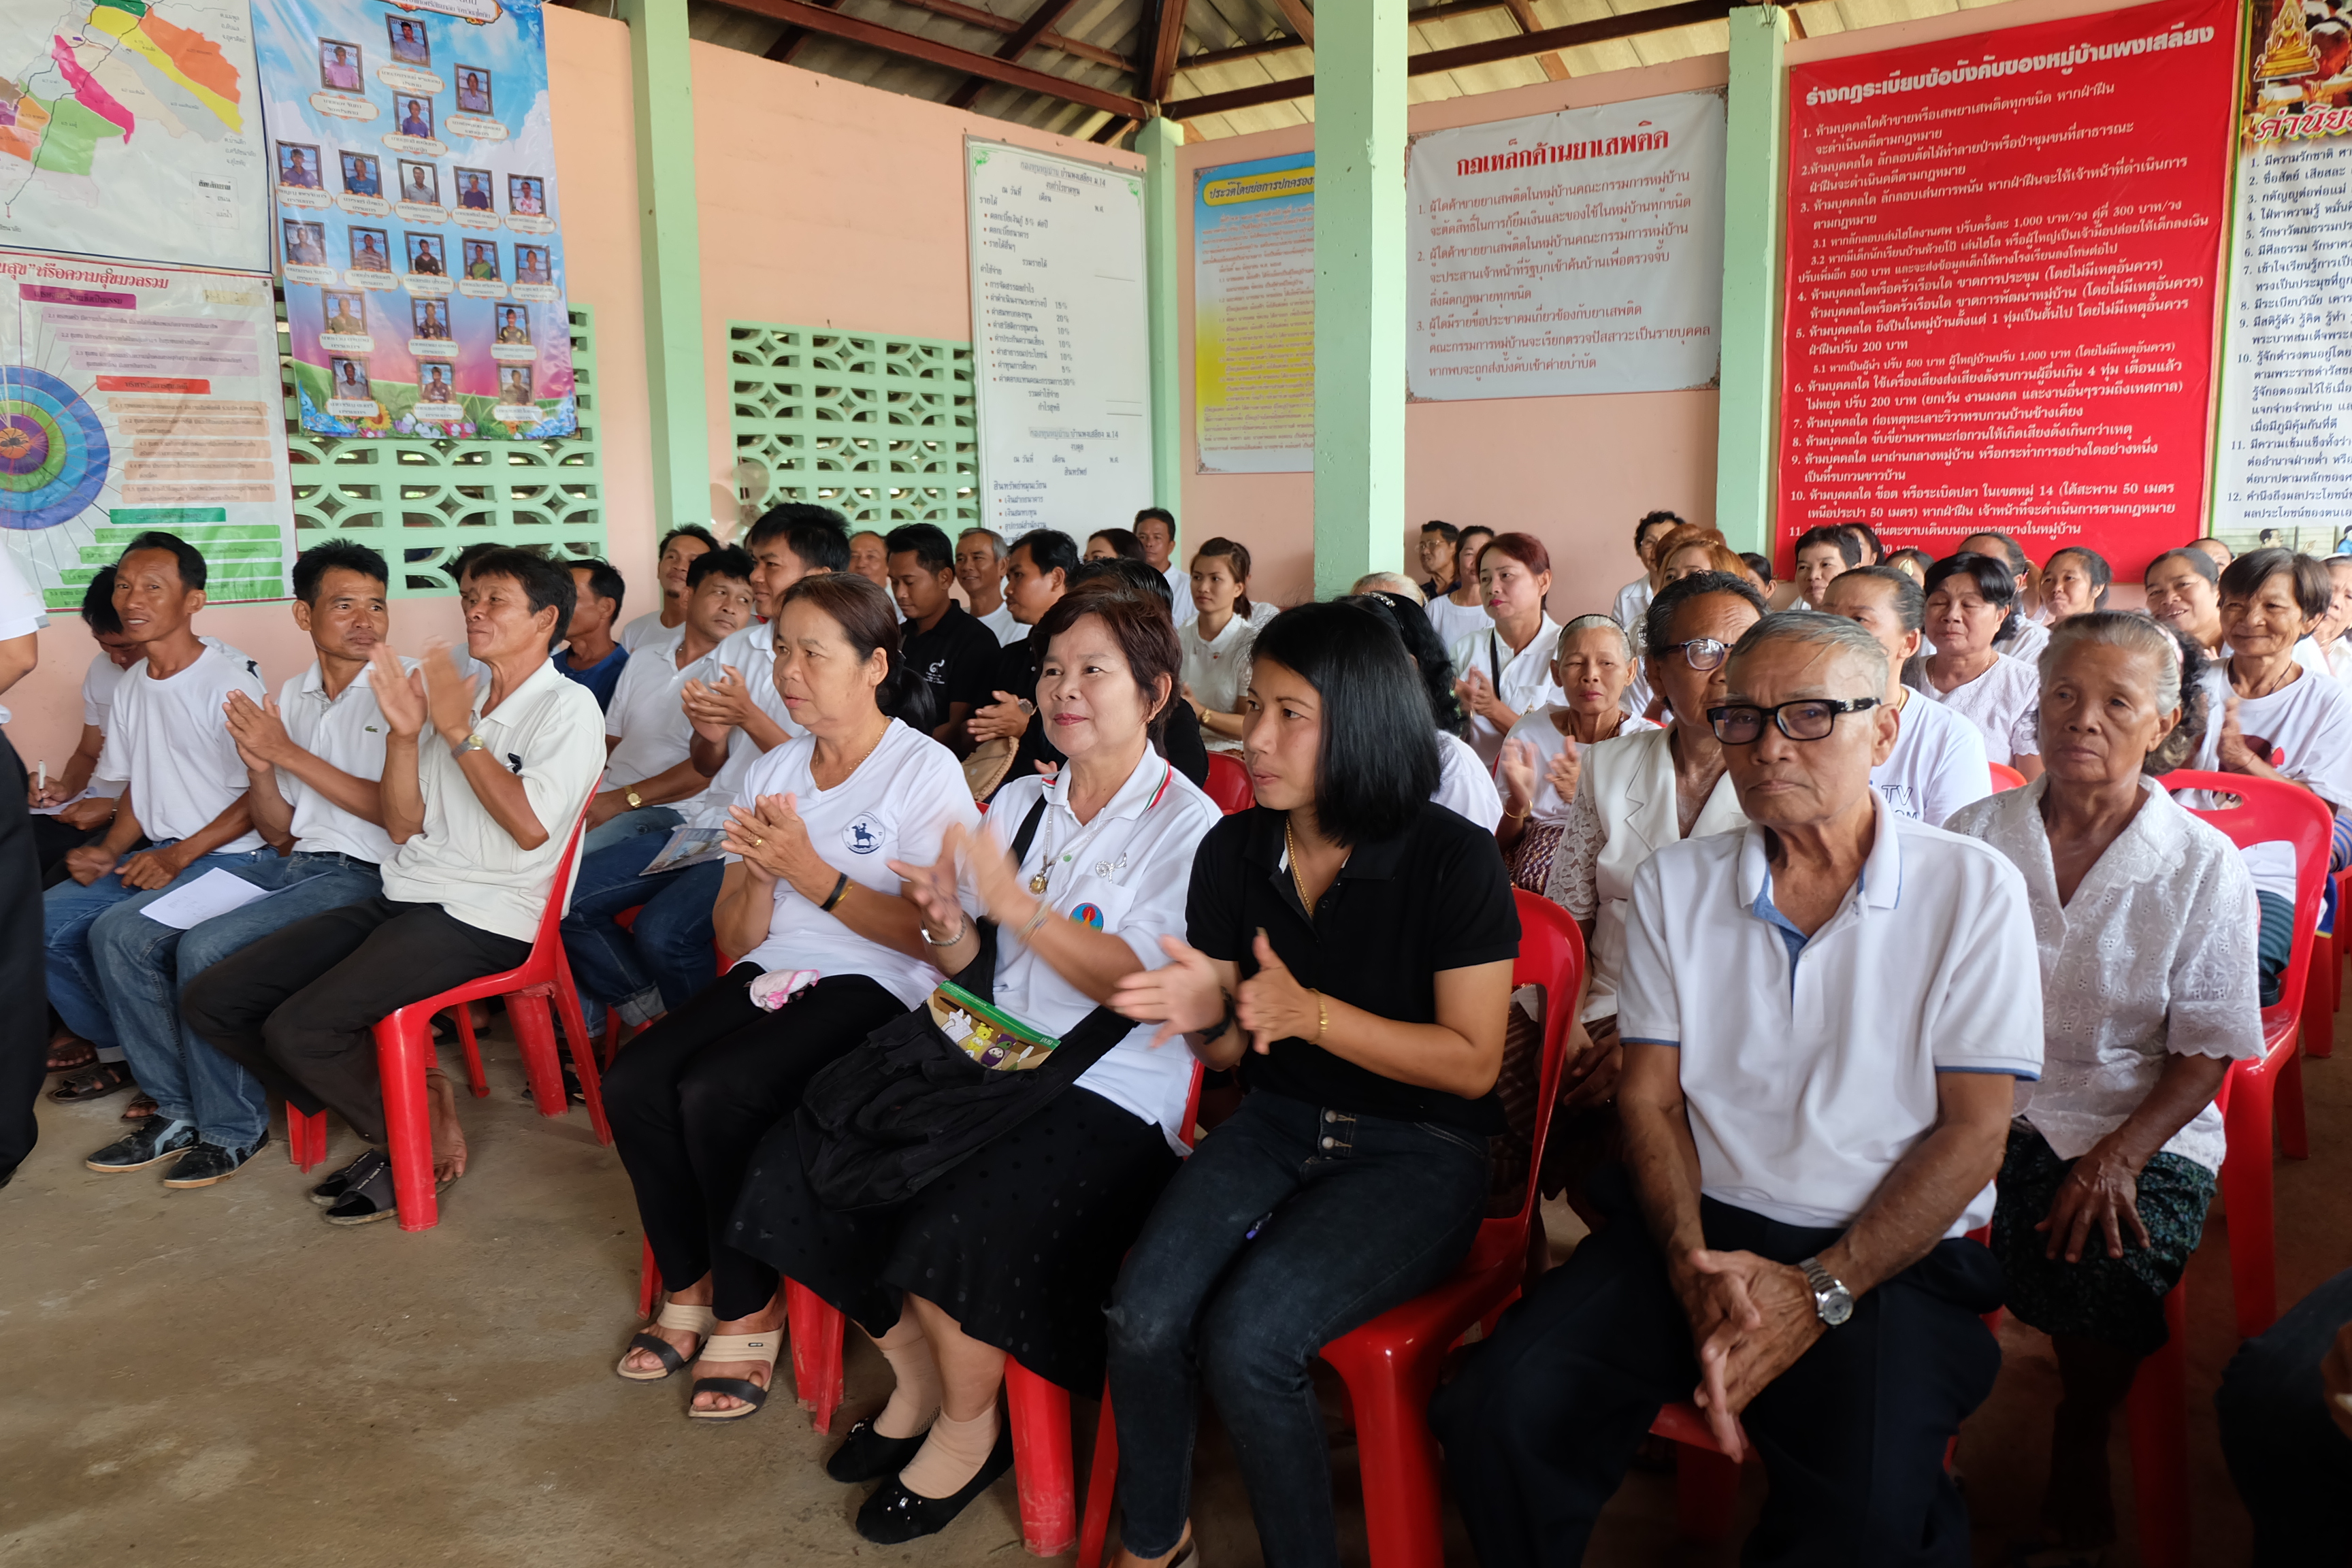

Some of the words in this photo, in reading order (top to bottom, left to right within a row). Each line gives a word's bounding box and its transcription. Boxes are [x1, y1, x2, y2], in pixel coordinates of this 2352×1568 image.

[1803, 127, 1811, 138] 1.
[2057, 81, 2114, 101] หากฝ่าฝืน
[1801, 153, 1872, 177] 2.ห้ามบุคคลใด
[2251, 157, 2259, 167] 1.
[1209, 178, 1315, 200] ประวัติโดยย่อการปกครอง
[2249, 176, 2257, 186] 2.
[979, 193, 998, 206] รายได้
[1799, 202, 1810, 213] 3.
[1813, 191, 1876, 214] ห้ามบุคคลใด
[2247, 194, 2257, 203] 3.
[1418, 203, 1426, 214] 1.
[2247, 211, 2255, 221] 4.
[1813, 214, 1876, 230] ตามกฎหมาย
[1416, 250, 1426, 262] 2.
[1810, 255, 1825, 265] 3.2
[1960, 234, 2001, 250] เล่นไฮโล
[2244, 248, 2253, 257] 6.
[1797, 265, 1846, 283] ปรับเพิ่มอีก
[1850, 267, 1867, 278] 500
[1870, 266, 1891, 276] บาท
[1797, 291, 1807, 301] 4.
[1957, 271, 2039, 288] ขาดการประชุม
[1429, 284, 1531, 308] สิ่งผิดกฎหมายทุกชนิด
[2240, 301, 2249, 310] 8.
[1416, 320, 1425, 331] 3.
[1795, 327, 1805, 338] 5.
[1808, 319, 1872, 342] ห้ามบุคคลใด
[1992, 313, 1997, 324] 1
[2003, 304, 2073, 329] ทุ่มเป็นต้นไป
[2239, 318, 2248, 327] 9.
[1808, 338, 1858, 355] ฝ่าฝืนปรับ
[1861, 340, 1882, 352] 200
[1885, 340, 1908, 350] บาท
[1794, 382, 1803, 393] 6.
[1808, 375, 1869, 397] ห้ามบุคคลใด
[2087, 365, 2095, 376] 4
[2100, 362, 2119, 382] ทุ่ม
[2124, 357, 2182, 374] เตือนแล้ว
[1793, 418, 1802, 429] 7.
[1806, 412, 1868, 433] ห้ามบุคคลใด
[1792, 436, 1801, 447] 8.
[1805, 430, 1867, 451] ห้ามบุคคลใด
[1791, 455, 1801, 465] 9.
[1804, 448, 1866, 464] ห้ามบุคคลใด
[1791, 490, 1806, 501] 10.
[1809, 485, 1872, 506] ห้ามบุคคลใด
[1874, 484, 1898, 499] ช็อต
[1901, 484, 1978, 499] หรือระเบิดปลา
[1982, 482, 2034, 497] ในเขตหมู่
[2039, 485, 2053, 495] 14
[2058, 480, 2117, 496] (ใต้สะพาน
[2122, 483, 2138, 494] 50
[2143, 483, 2174, 493] เมตร
[1808, 504, 1865, 519] เหนือประปา
[1869, 506, 1884, 518] 50
[1887, 506, 1917, 518] เมตร)
[1922, 504, 1973, 517] หากฝ่าฝืน
